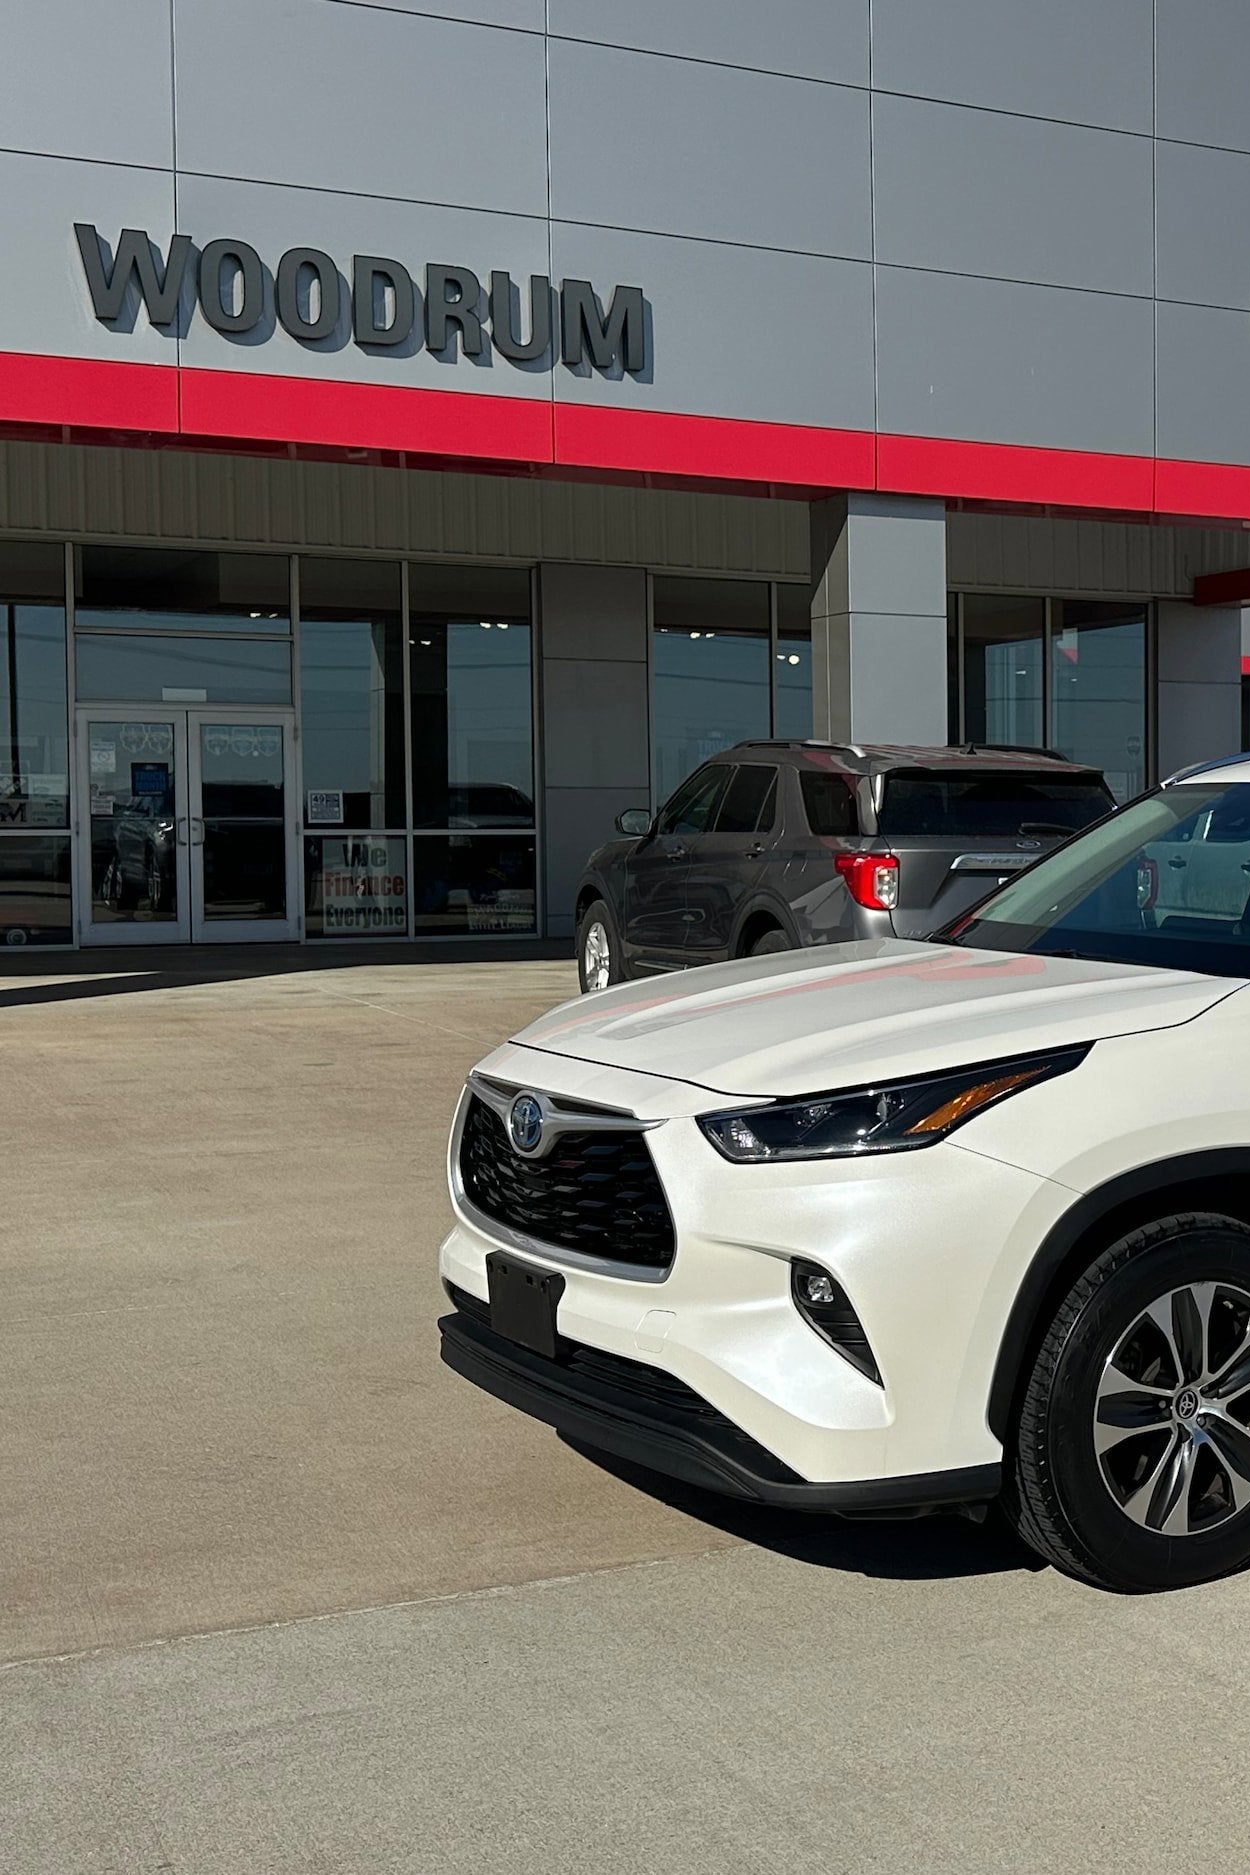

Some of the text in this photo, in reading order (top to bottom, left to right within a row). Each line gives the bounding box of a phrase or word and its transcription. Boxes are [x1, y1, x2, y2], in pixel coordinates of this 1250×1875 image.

[74, 223, 645, 372] WOODRUM
[343, 844, 386, 867] We
[325, 872, 404, 896] Finance
[326, 904, 404, 928] Everyone
